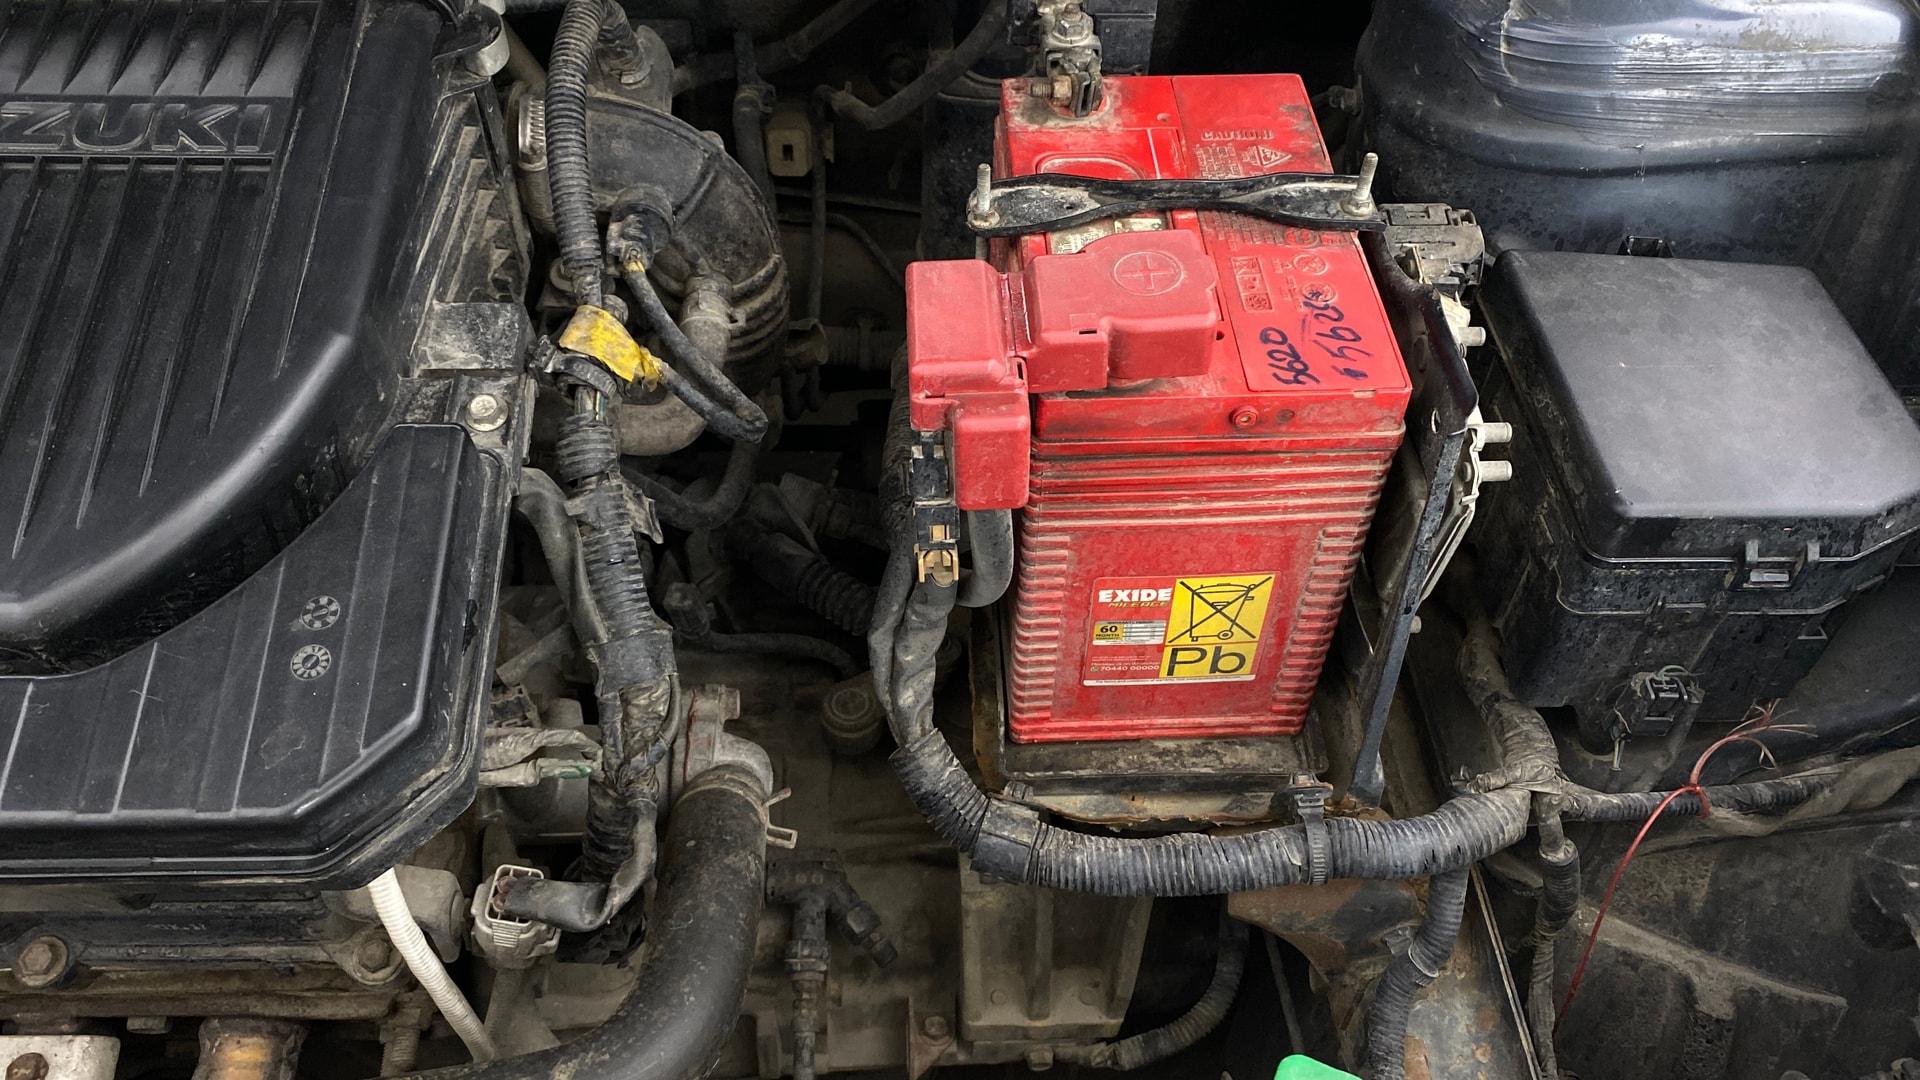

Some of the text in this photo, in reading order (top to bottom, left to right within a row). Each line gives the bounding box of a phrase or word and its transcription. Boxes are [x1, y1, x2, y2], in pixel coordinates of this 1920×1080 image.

[1098, 588, 1173, 602] EXIDE
[1100, 625, 1118, 633] 60
[1166, 645, 1247, 677] Pb
